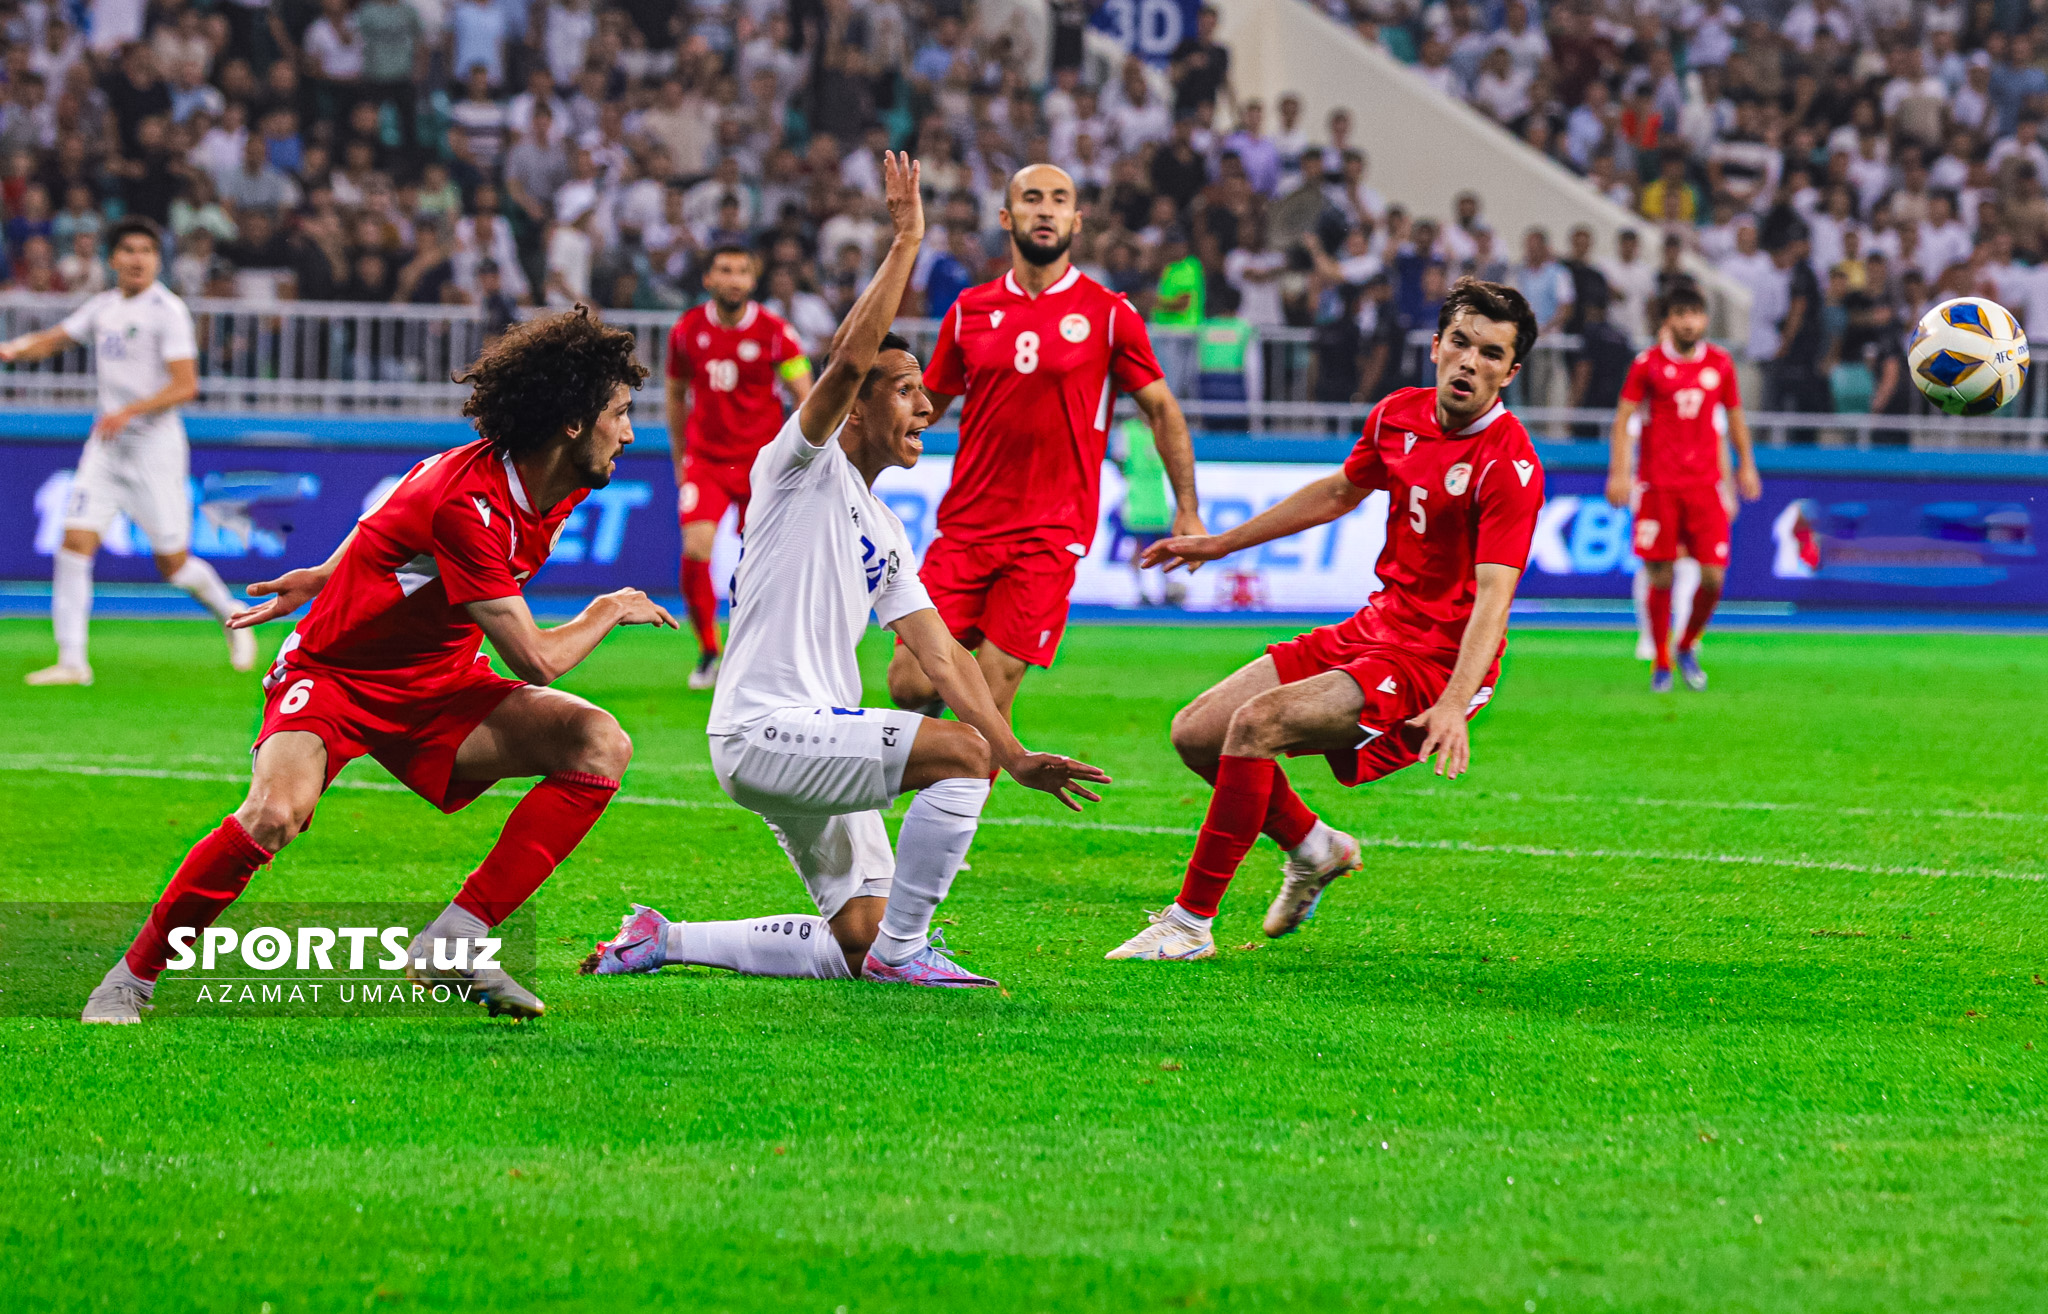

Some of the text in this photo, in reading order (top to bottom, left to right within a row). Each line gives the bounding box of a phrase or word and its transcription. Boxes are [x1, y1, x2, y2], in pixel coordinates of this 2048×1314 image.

[1014, 330, 1041, 375] 8
[1673, 387, 1706, 420] 17
[1409, 485, 1429, 535] 5
[279, 678, 315, 715] 6
